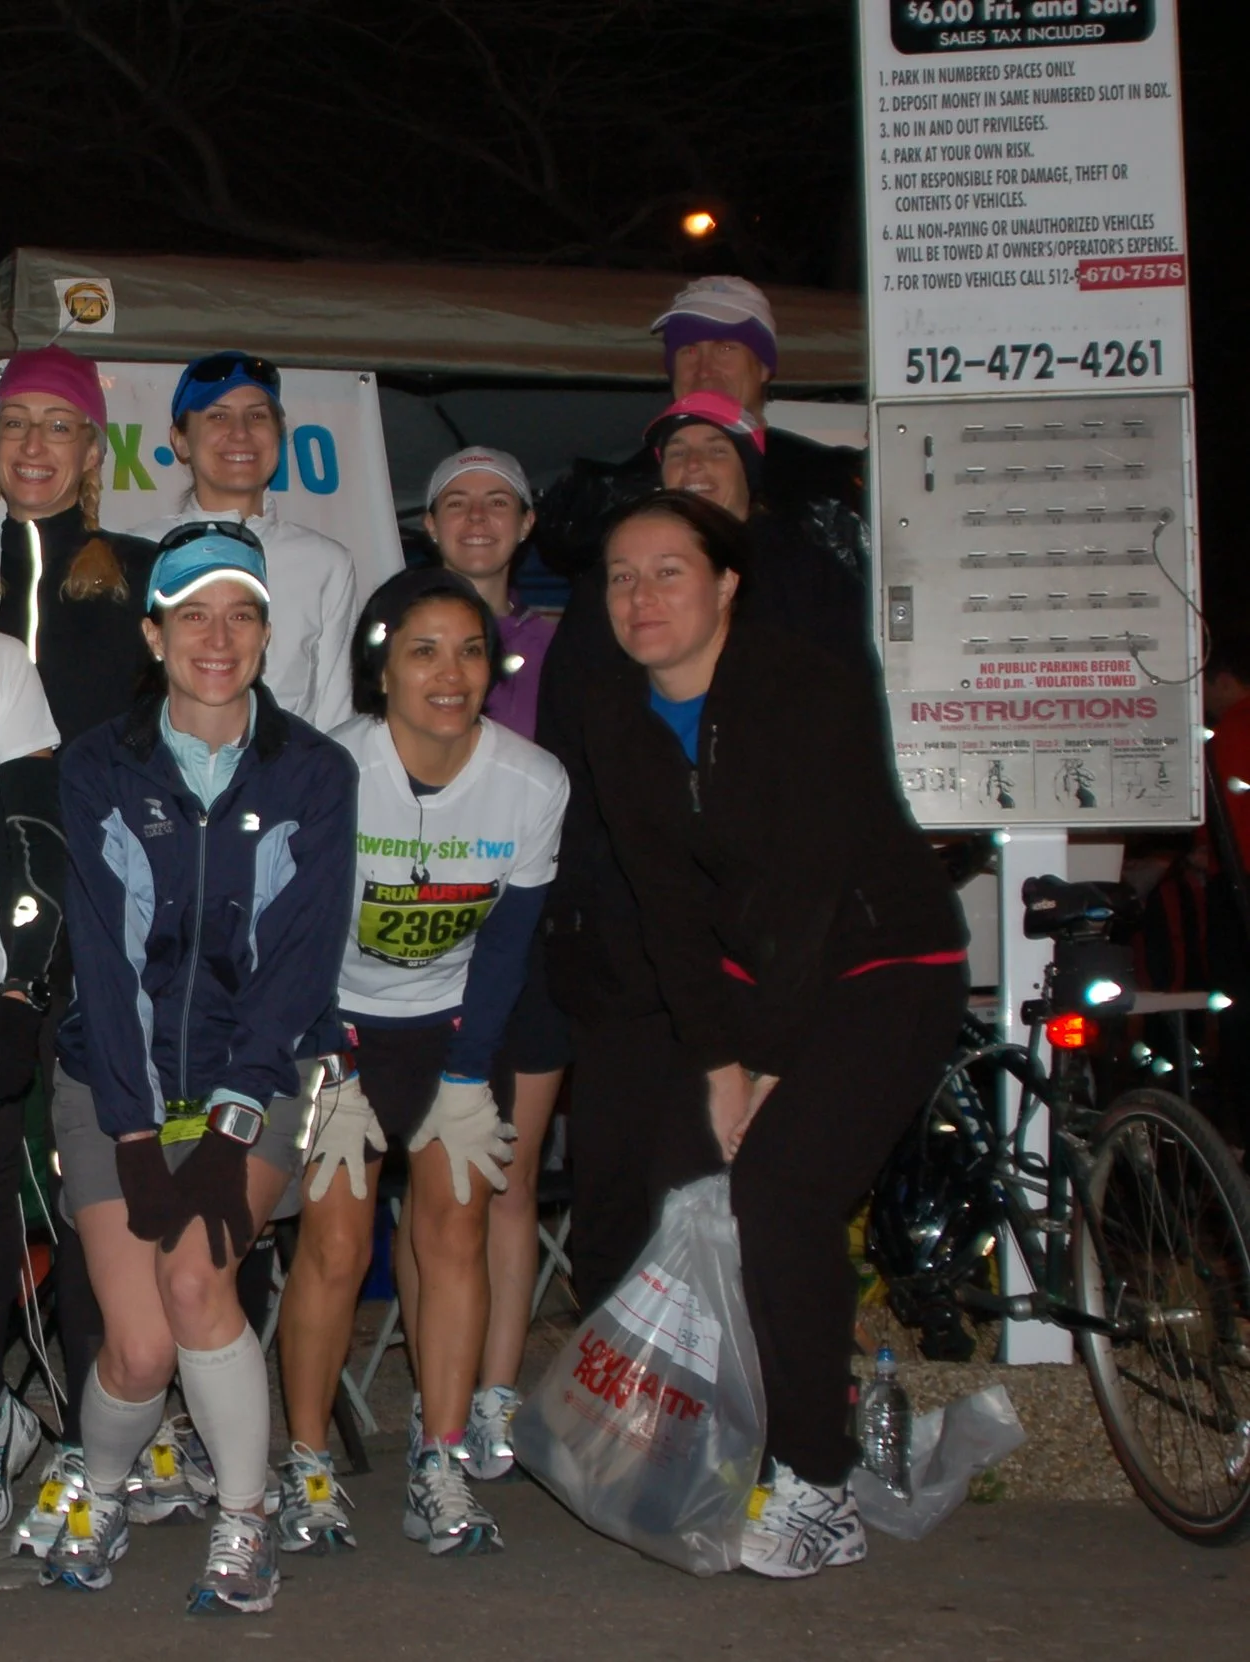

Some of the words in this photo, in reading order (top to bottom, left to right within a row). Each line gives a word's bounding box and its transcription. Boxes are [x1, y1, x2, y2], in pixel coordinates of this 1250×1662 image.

[940, 30, 985, 46] SALES
[993, 28, 1022, 43] TAX
[1028, 24, 1105, 41] INCLUDED
[879, 71, 888, 87] 1.
[892, 70, 919, 86] PARK
[923, 68, 934, 84] IN
[939, 64, 1000, 83] NUMBERED
[1004, 62, 1042, 80] SPACES
[1046, 60, 1076, 77] ONLY.
[879, 96, 889, 112] 2.
[893, 93, 937, 112] DEPOSIT
[942, 91, 980, 109] MONEY
[985, 91, 997, 106] IN
[1001, 88, 1028, 106] SAME
[1033, 85, 1095, 104] NUMBERED
[1098, 84, 1124, 101] SLOT
[1129, 83, 1141, 100] IN
[1145, 82, 1170, 99] BOX.
[880, 122, 890, 139] 3.
[893, 121, 910, 138] NO
[914, 120, 926, 136] IN
[930, 119, 953, 136] AND
[957, 117, 980, 135] OUT
[983, 114, 1048, 133] PRIVILEGES.
[881, 148, 890, 165] 4.
[895, 147, 922, 164] PARK
[925, 145, 937, 162] AT
[940, 144, 971, 162] YOUR
[975, 143, 1002, 160] OWN
[1006, 141, 1034, 159] RISK.
[882, 175, 891, 191] 5.
[895, 173, 917, 190] NOT
[921, 169, 992, 189] RESPONSIBLE
[997, 168, 1018, 185] FOR
[1022, 166, 1072, 185] DAMAGE,
[1076, 164, 1108, 182] THEFT
[1112, 163, 1128, 180] OR
[896, 194, 951, 212] CONTENTS
[955, 193, 970, 210] OF
[973, 190, 1027, 209] VEHICLES.
[882, 224, 893, 241] 6.
[896, 226, 913, 240] ALL
[918, 220, 988, 239] NON-PAYING
[992, 219, 1007, 236] OR
[1011, 215, 1099, 235] UNAUTHORIZED
[1103, 213, 1154, 231] VEHICLES
[898, 246, 924, 263] WILL
[927, 245, 940, 261] BE
[943, 243, 983, 261] TOWED
[986, 242, 1000, 258] AT
[1128, 236, 1178, 253] EXPENSE.
[884, 275, 894, 292] 7.
[898, 274, 920, 291] FOR
[923, 272, 963, 289] TOWED
[966, 270, 1016, 288] VEHICLES
[1020, 269, 1046, 285] CALL
[906, 340, 1162, 384] 512-472-4261
[980, 662, 994, 674] NO
[998, 661, 1037, 673] PUBLIC
[1040, 661, 1087, 673] PARKING
[1091, 660, 1131, 672] BEFORE
[976, 678, 1000, 689] 6:00
[1004, 679, 1026, 690] p.m.
[1036, 676, 1094, 688] VIOLATORS
[1098, 675, 1136, 687] TOWED
[911, 698, 1158, 722] INSTRUCTIONS
[377, 907, 477, 946] 2369
